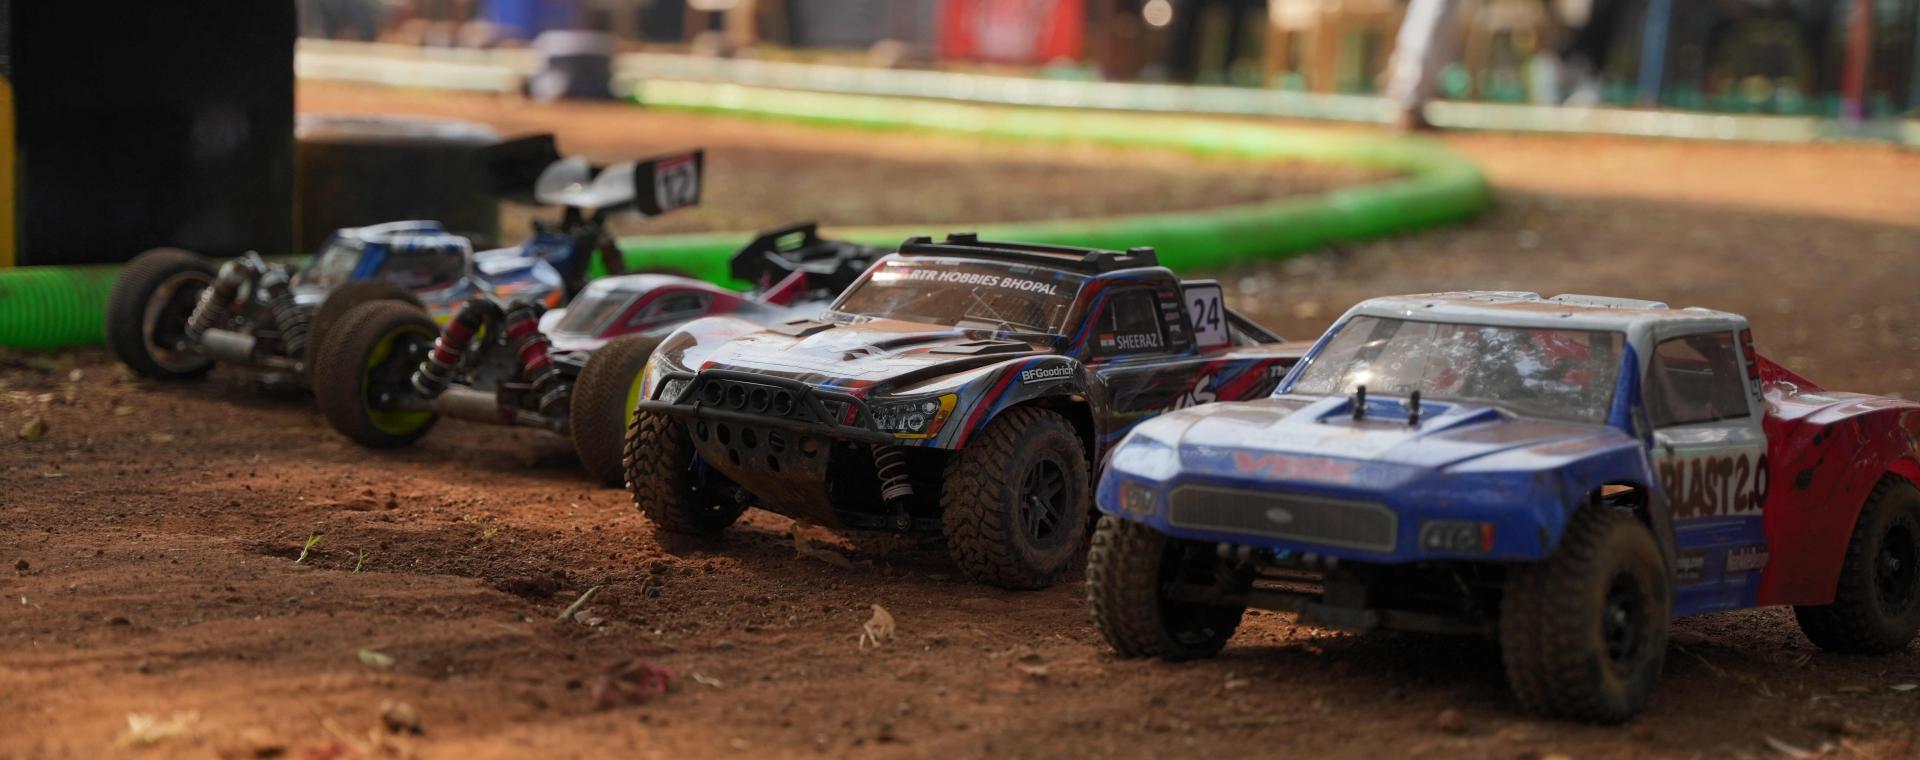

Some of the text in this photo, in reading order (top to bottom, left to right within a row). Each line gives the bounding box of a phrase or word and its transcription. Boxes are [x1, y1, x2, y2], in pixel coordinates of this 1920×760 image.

[910, 269, 938, 280] RTR
[938, 270, 1000, 286] HOBBIES
[1000, 277, 1057, 296] BHOPAL
[1194, 297, 1219, 333] 24
[1116, 333, 1158, 350] SHEERAZ
[1021, 365, 1073, 380] BFGoodrich
